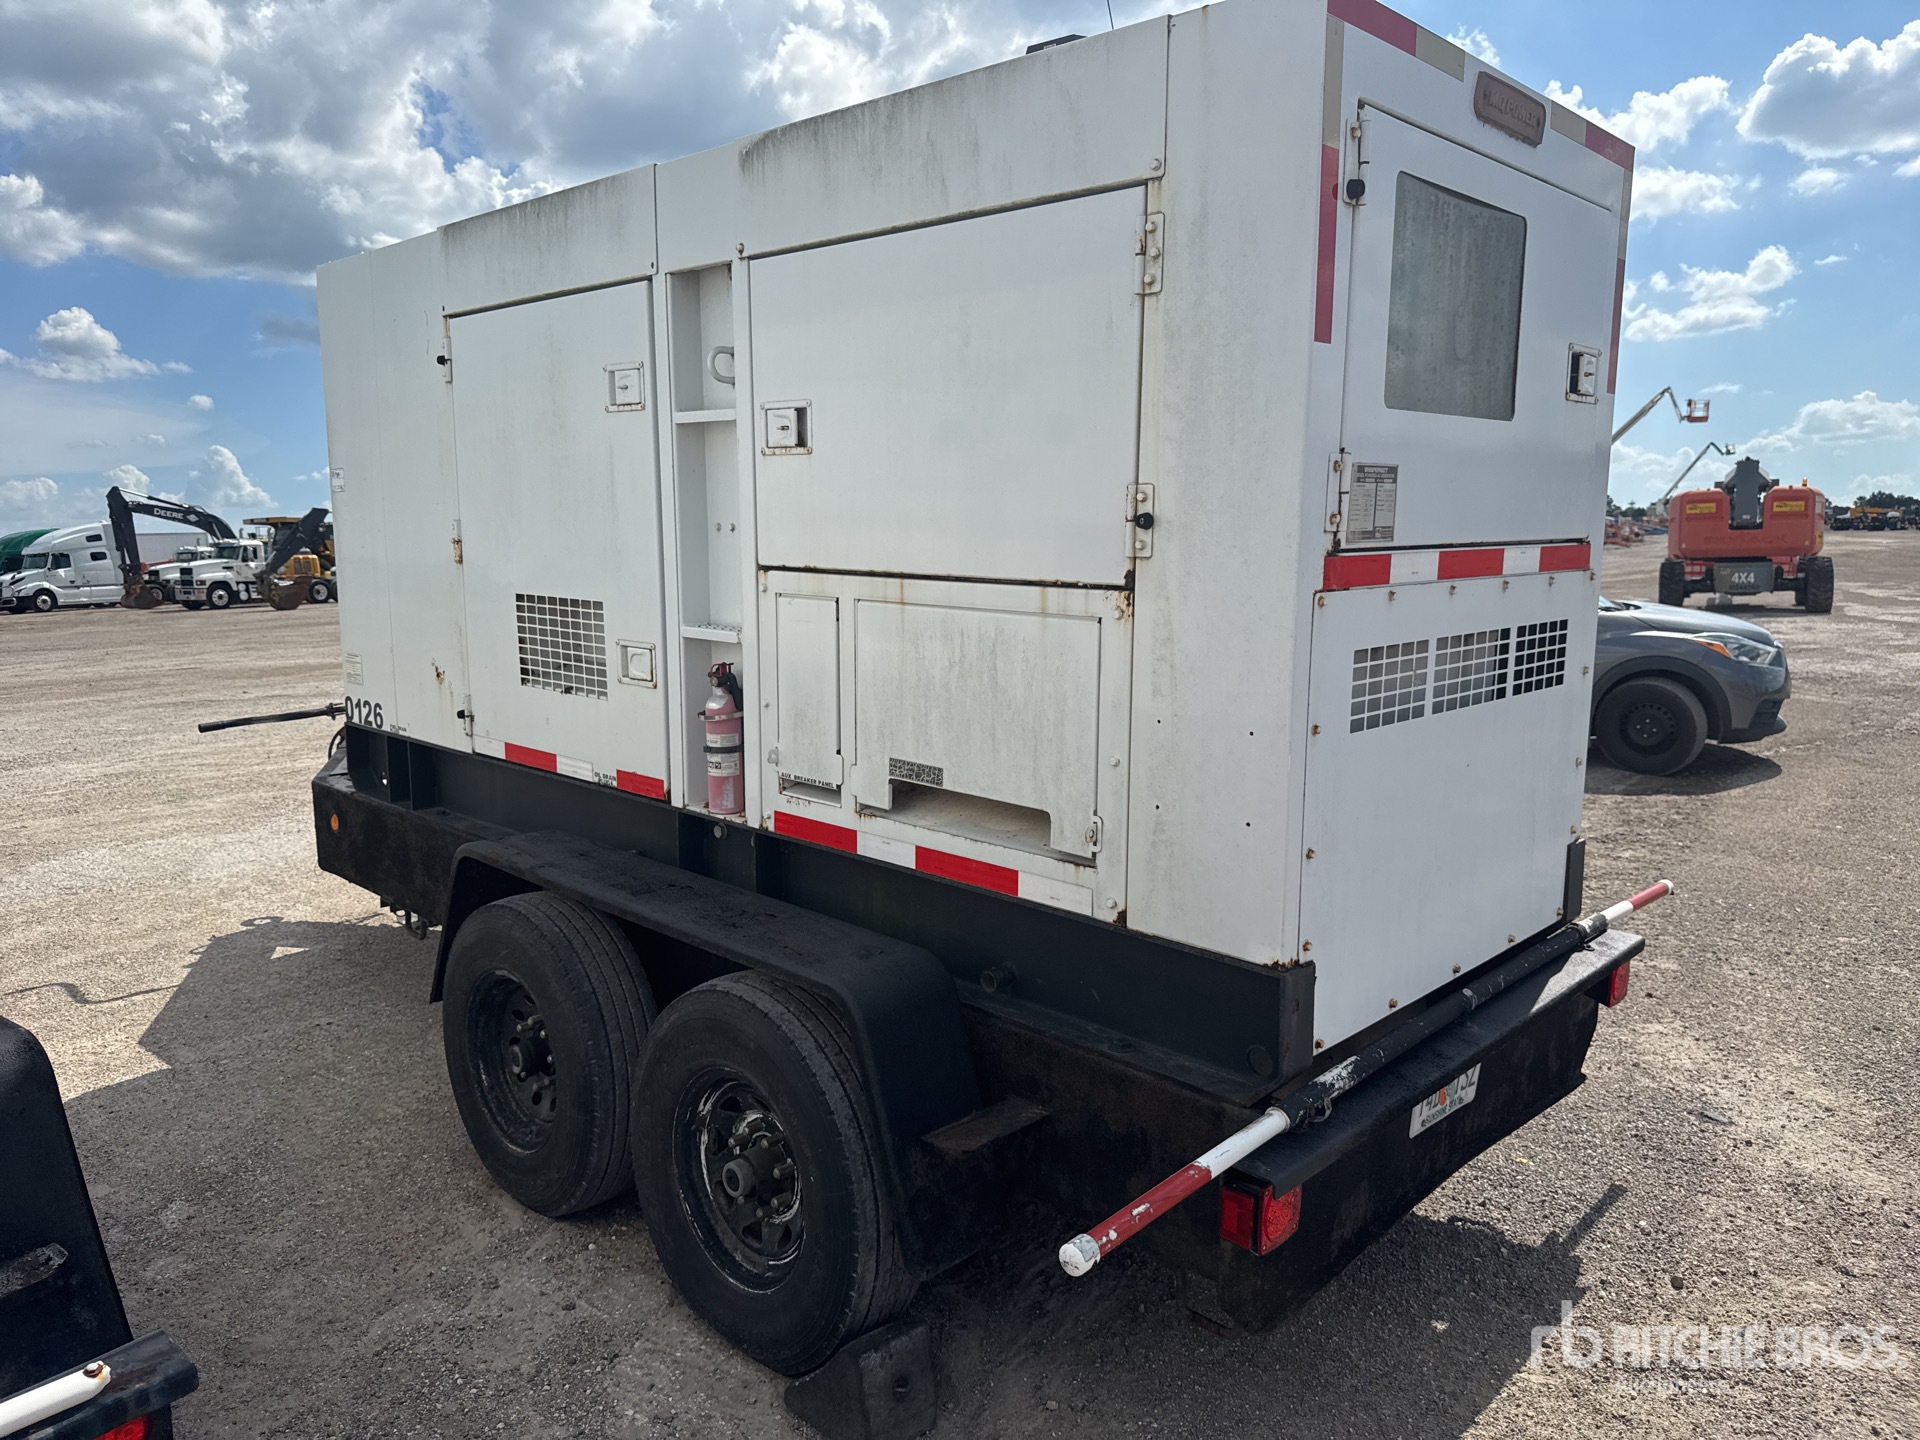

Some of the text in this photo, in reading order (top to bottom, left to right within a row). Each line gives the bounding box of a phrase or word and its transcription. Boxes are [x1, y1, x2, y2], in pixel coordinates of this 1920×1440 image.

[1506, 98, 1537, 129] POWER
[154, 508, 184, 520] DEERE
[1731, 572, 1755, 584] 4X4
[345, 696, 384, 729] 0126
[794, 775, 817, 784] BREAKER
[818, 780, 834, 788] PANEL
